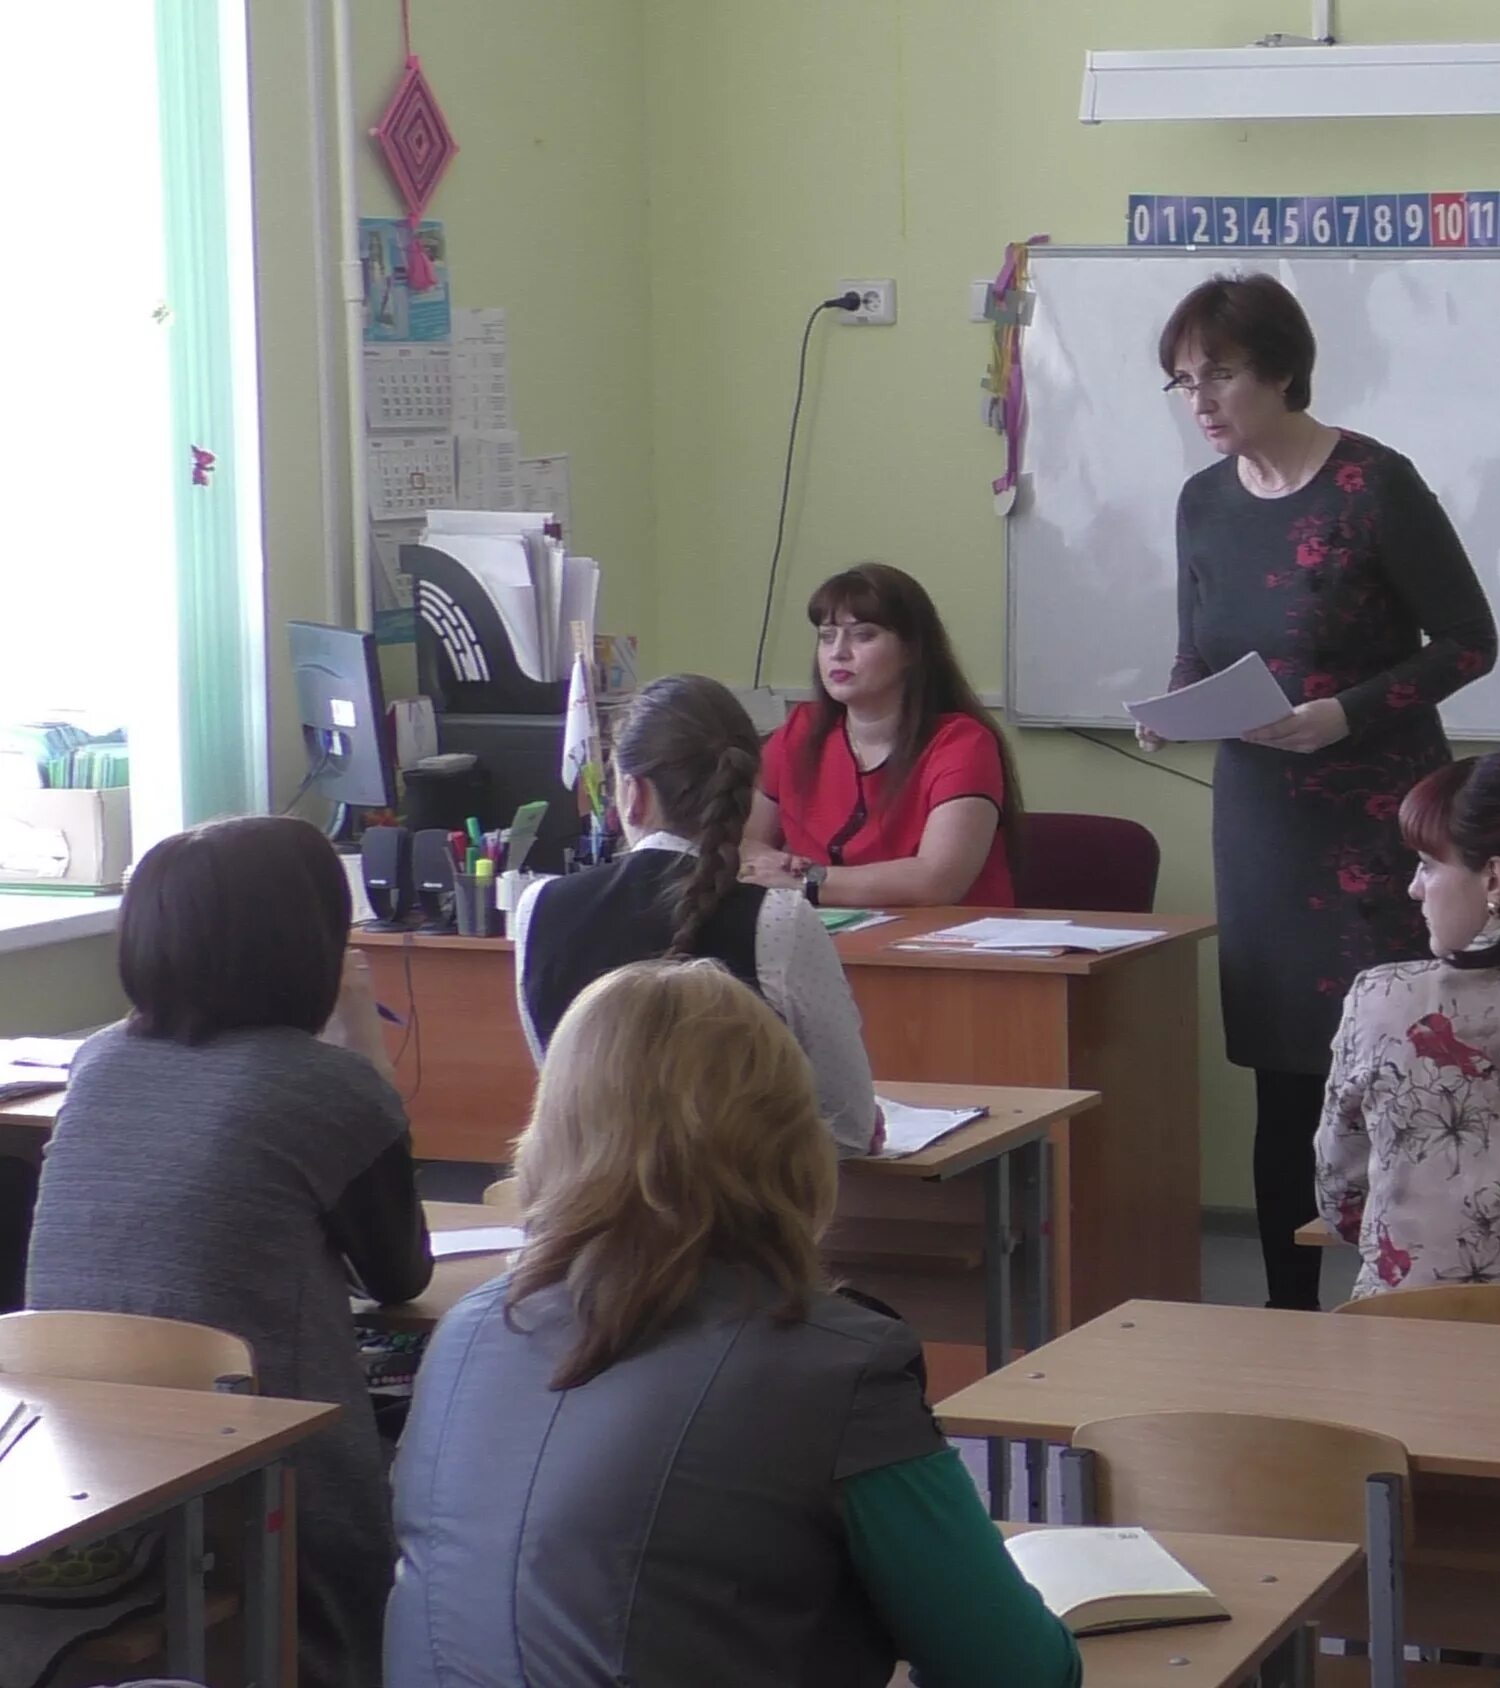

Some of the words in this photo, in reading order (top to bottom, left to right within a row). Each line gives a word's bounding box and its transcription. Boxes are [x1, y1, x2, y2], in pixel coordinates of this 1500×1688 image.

[1133, 204, 1150, 242] 0
[1163, 206, 1177, 242] 1
[1192, 206, 1210, 243] 2
[1222, 207, 1239, 243] 3
[1252, 207, 1272, 244] 4
[1284, 207, 1299, 244] 5
[1312, 206, 1331, 243] 6
[1342, 206, 1360, 243] 7
[1374, 204, 1393, 242] 8
[1405, 204, 1424, 242] 9
[1433, 203, 1463, 242] 10
[1469, 201, 1494, 239] 11
